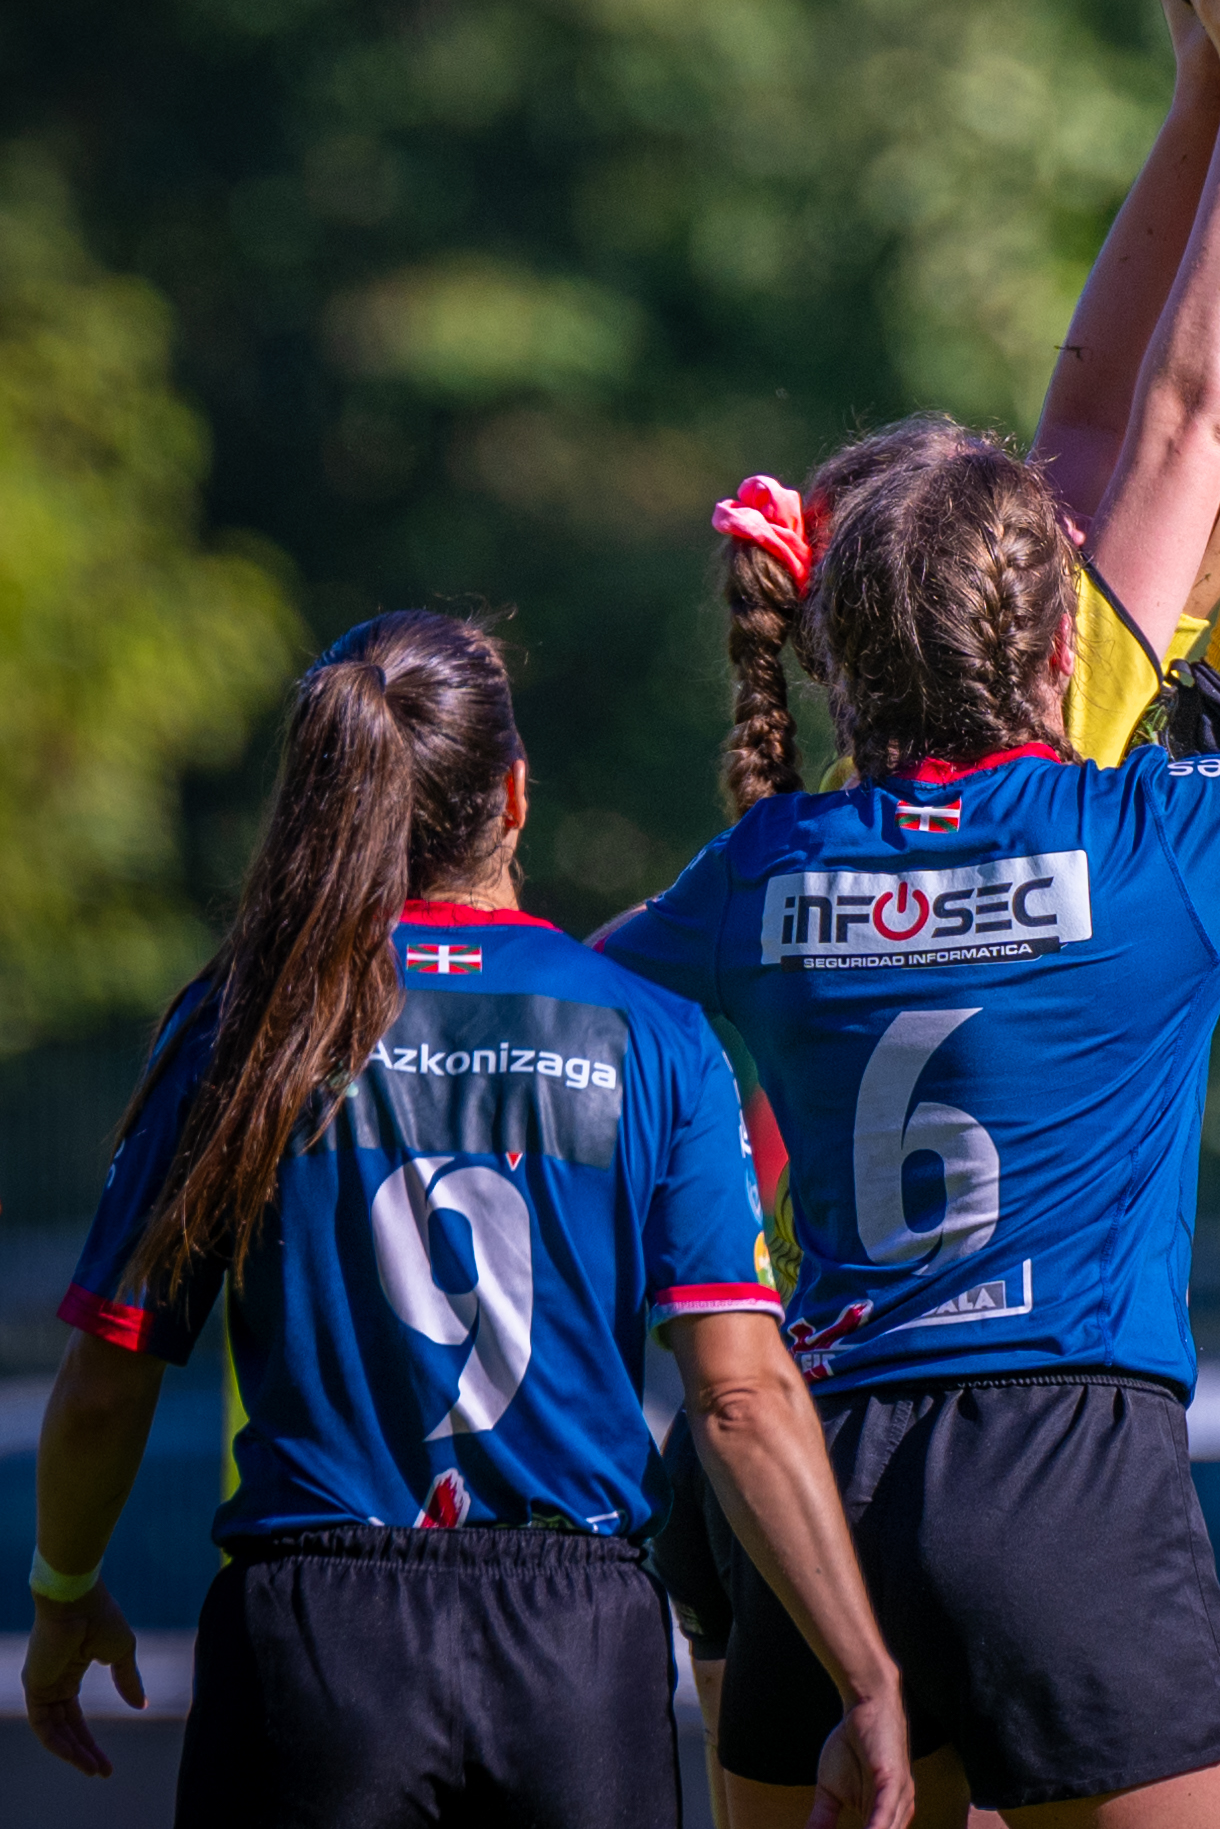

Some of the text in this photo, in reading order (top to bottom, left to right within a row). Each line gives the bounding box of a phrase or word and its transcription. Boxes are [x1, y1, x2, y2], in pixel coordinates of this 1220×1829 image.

[803, 942, 1032, 969] SEGURIDAD INFORMATICA
[369, 1040, 617, 1089] Azkonizaga
[852, 1007, 1000, 1276] 6
[370, 1156, 534, 1442] 9
